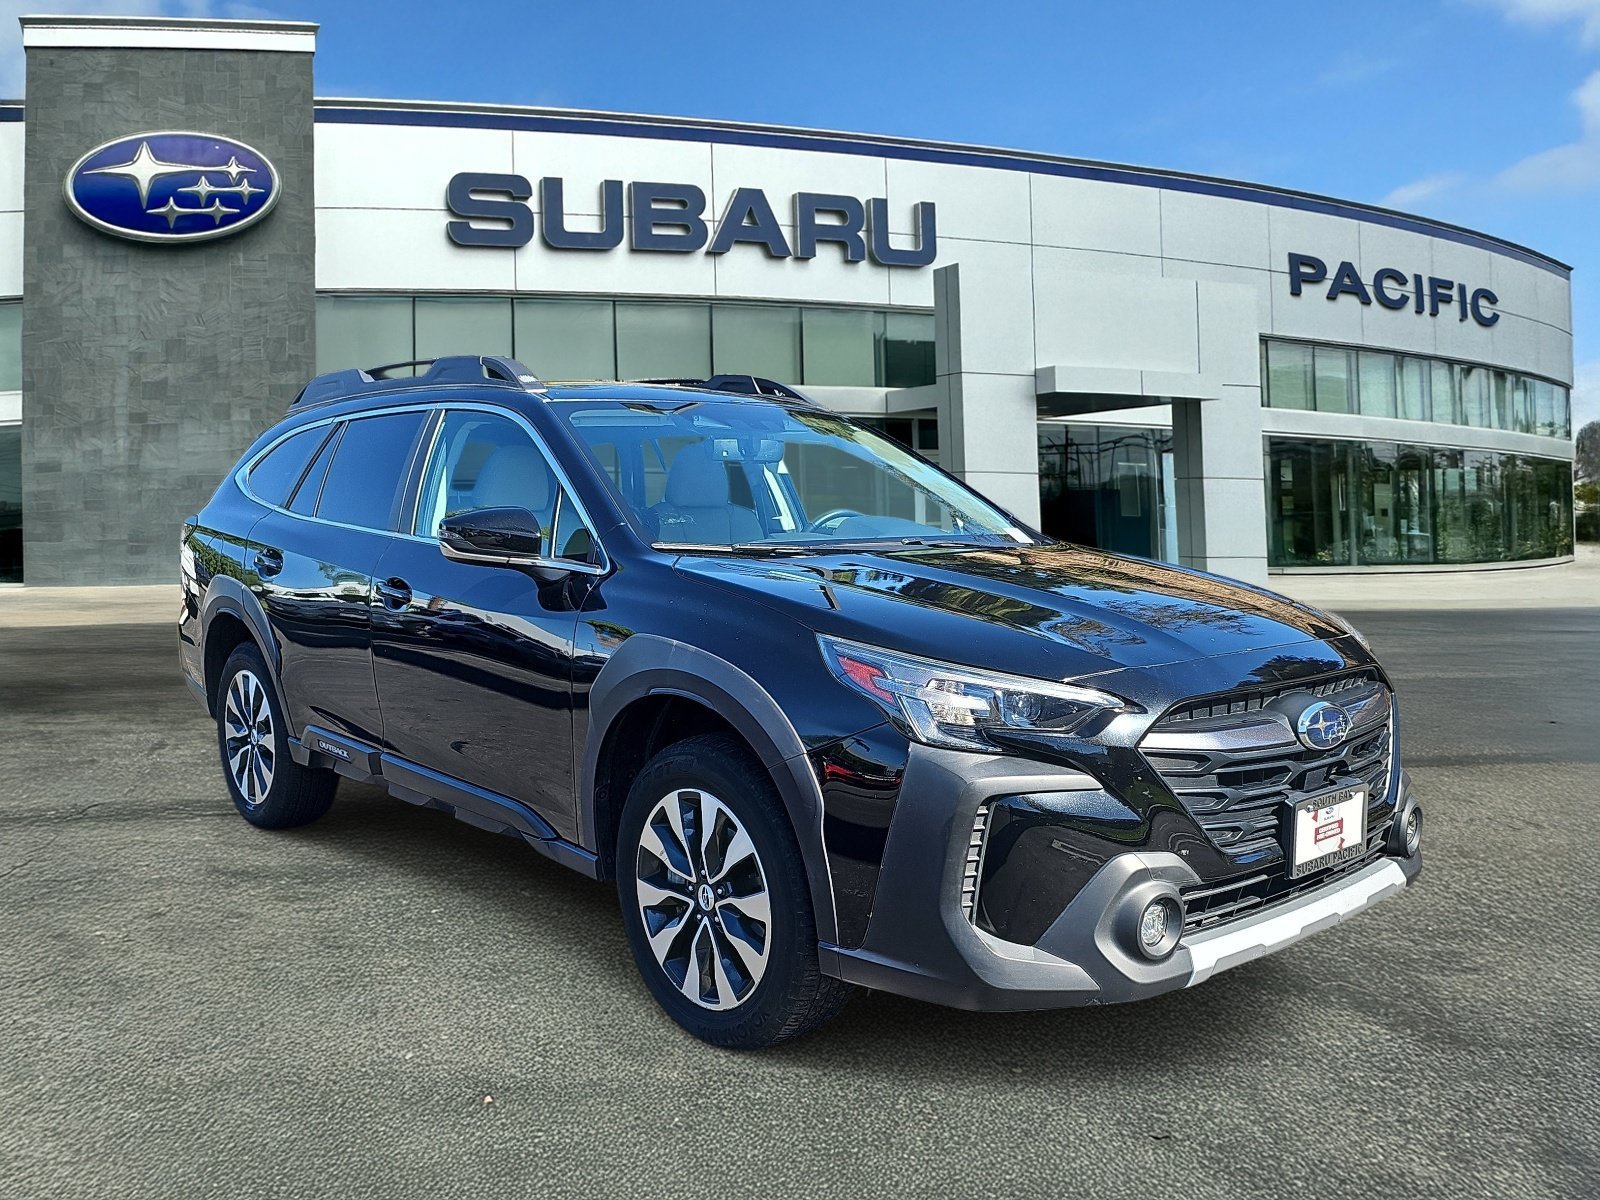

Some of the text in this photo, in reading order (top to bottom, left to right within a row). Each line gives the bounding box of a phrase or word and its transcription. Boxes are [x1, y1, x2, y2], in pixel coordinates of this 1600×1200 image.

[446, 172, 936, 267] SUBARU
[1288, 252, 1500, 327] PACIFIC
[319, 741, 349, 758] OUTBACK
[1312, 789, 1353, 808] SOUTH BAY
[1296, 843, 1364, 876] SUBARU PACIFIC
